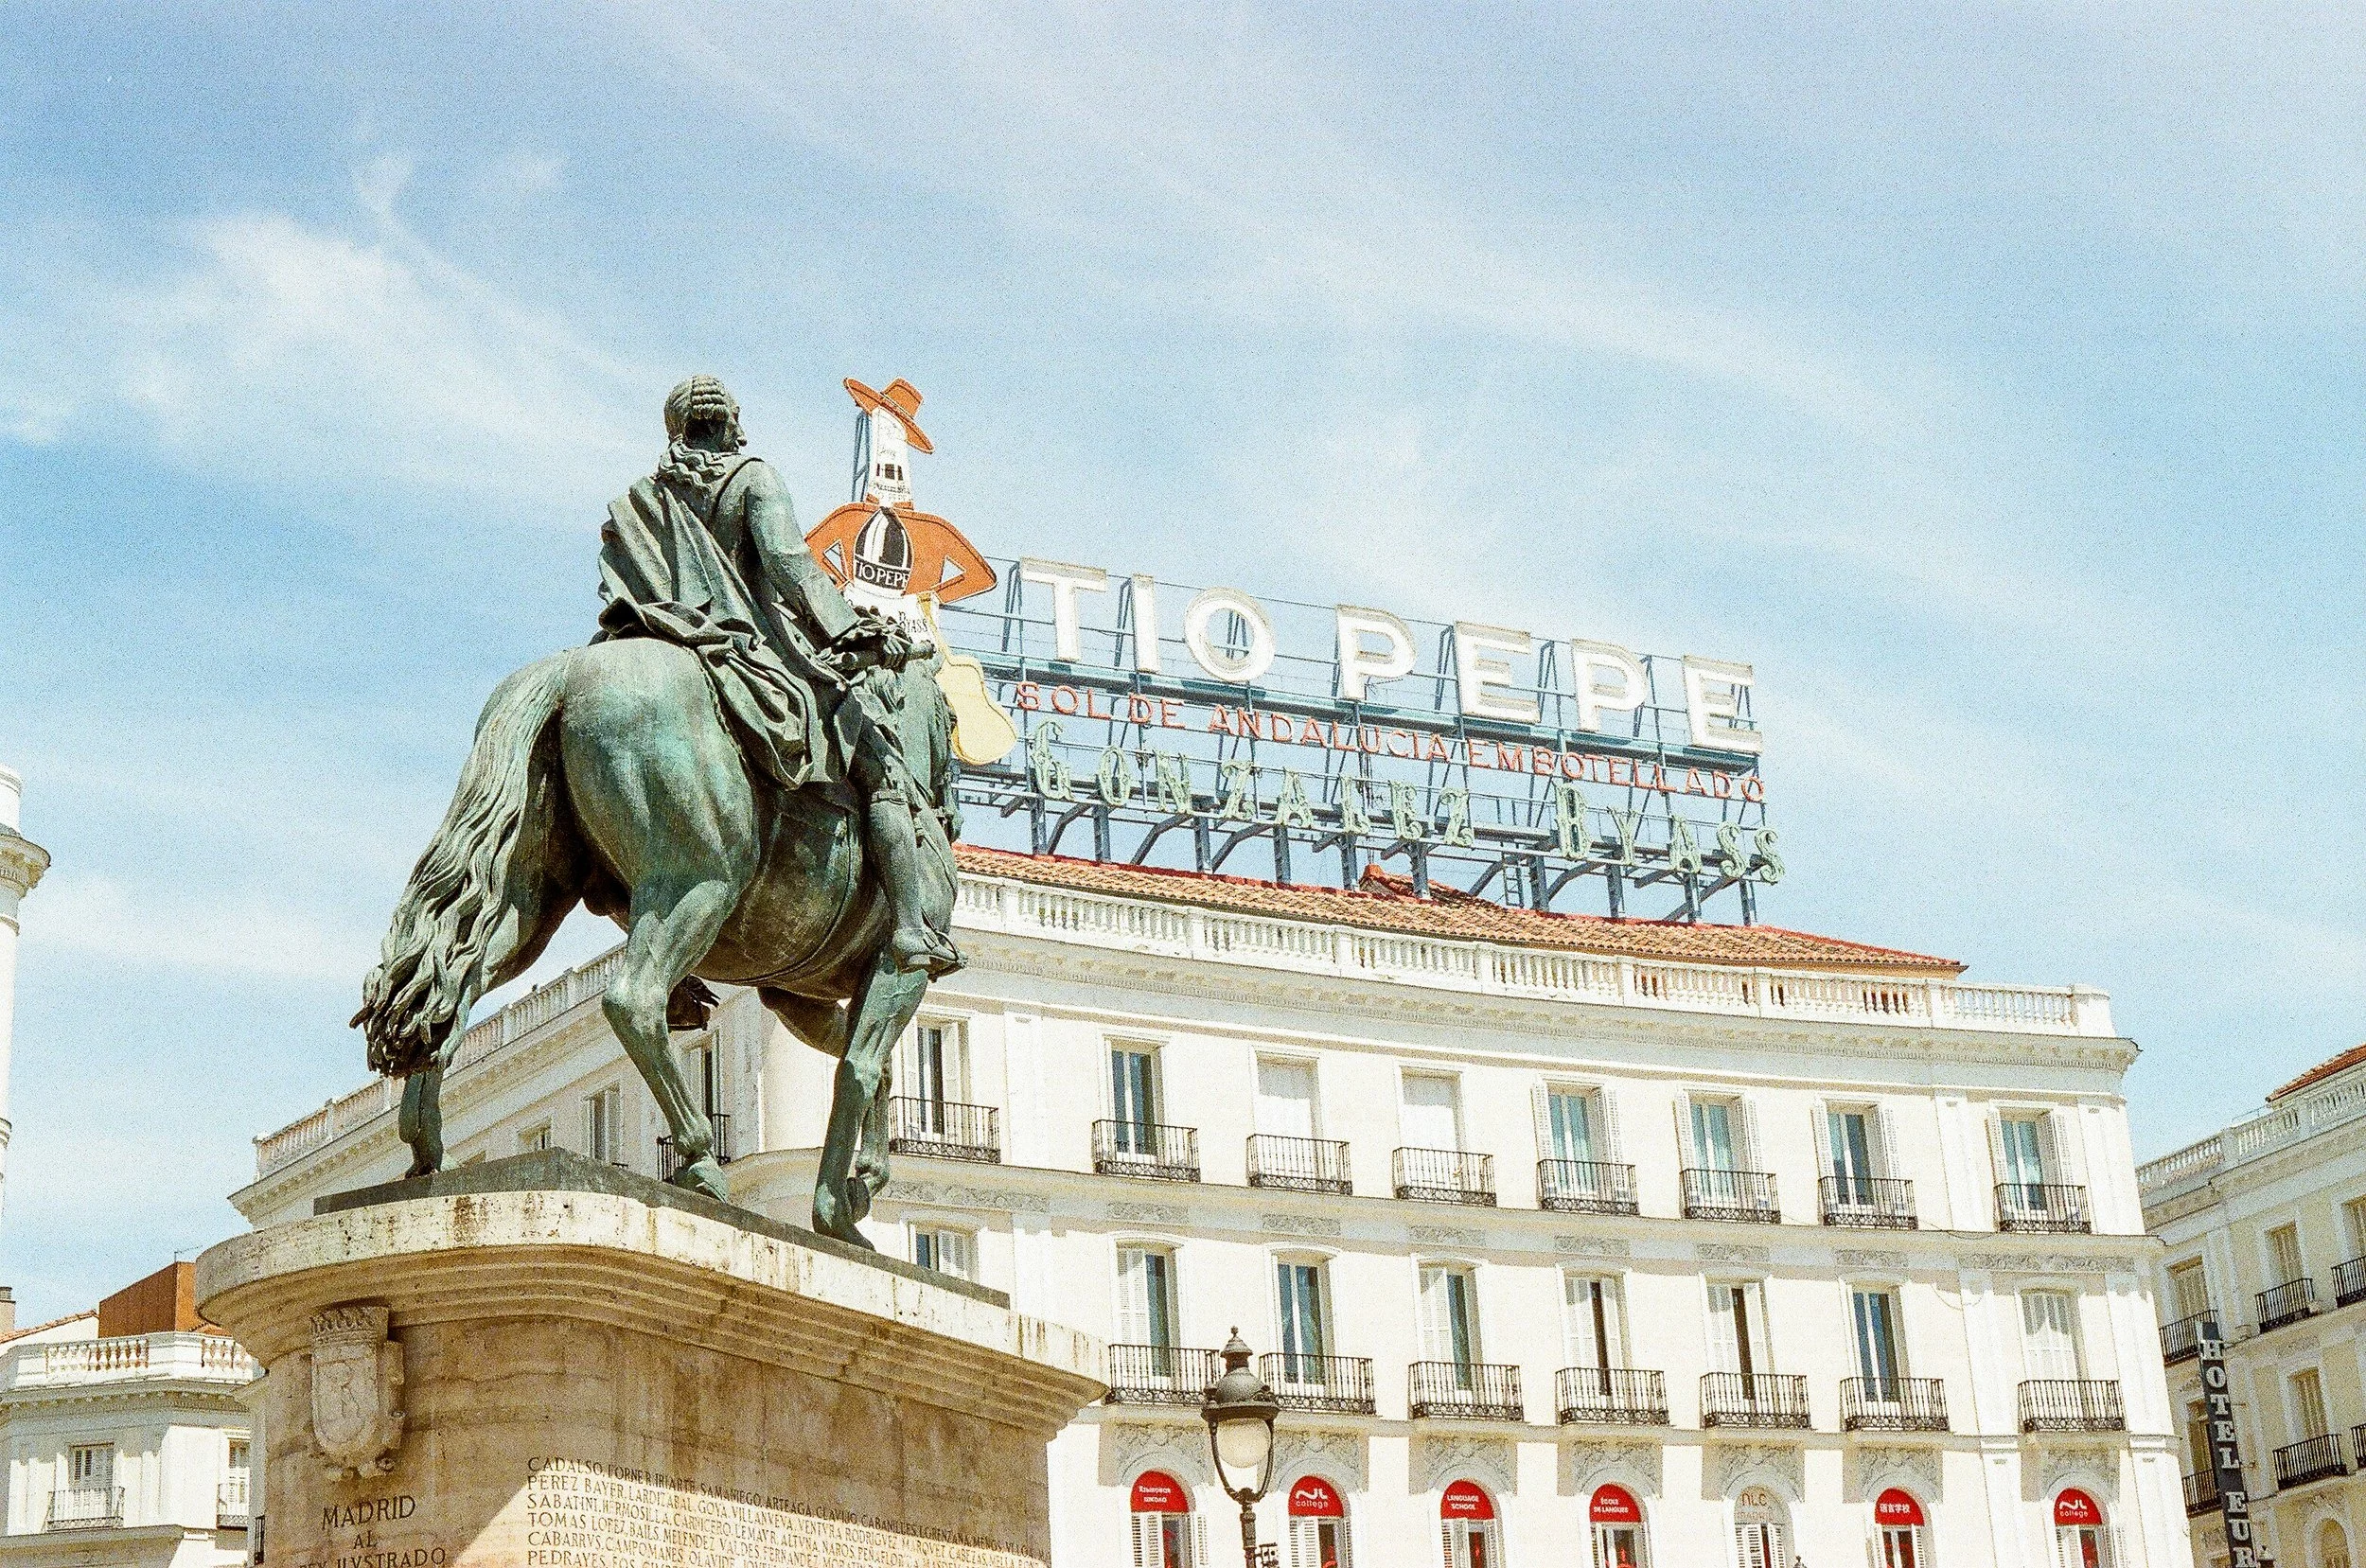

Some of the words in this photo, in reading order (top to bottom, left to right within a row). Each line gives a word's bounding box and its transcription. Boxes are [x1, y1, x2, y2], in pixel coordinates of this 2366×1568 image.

[876, 568, 909, 588] PEPE
[1019, 555, 1276, 682] TIO
[1335, 604, 1763, 757] PEPE
[1015, 680, 1112, 721] SOL
[1128, 693, 1186, 730] DE
[1207, 703, 1451, 765] ANDALUCIA
[1468, 737, 1766, 803] EMBOTELLADO
[1031, 721, 1474, 847] GONZALEZ
[1553, 778, 1785, 886] BYASS
[2199, 1339, 2239, 1470] HOTEL
[527, 1475, 578, 1491] PEREZ
[321, 1495, 415, 1530] MADRID
[527, 1512, 586, 1530] TOMAS
[2059, 1509, 2089, 1518] college
[353, 1530, 378, 1550] AL
